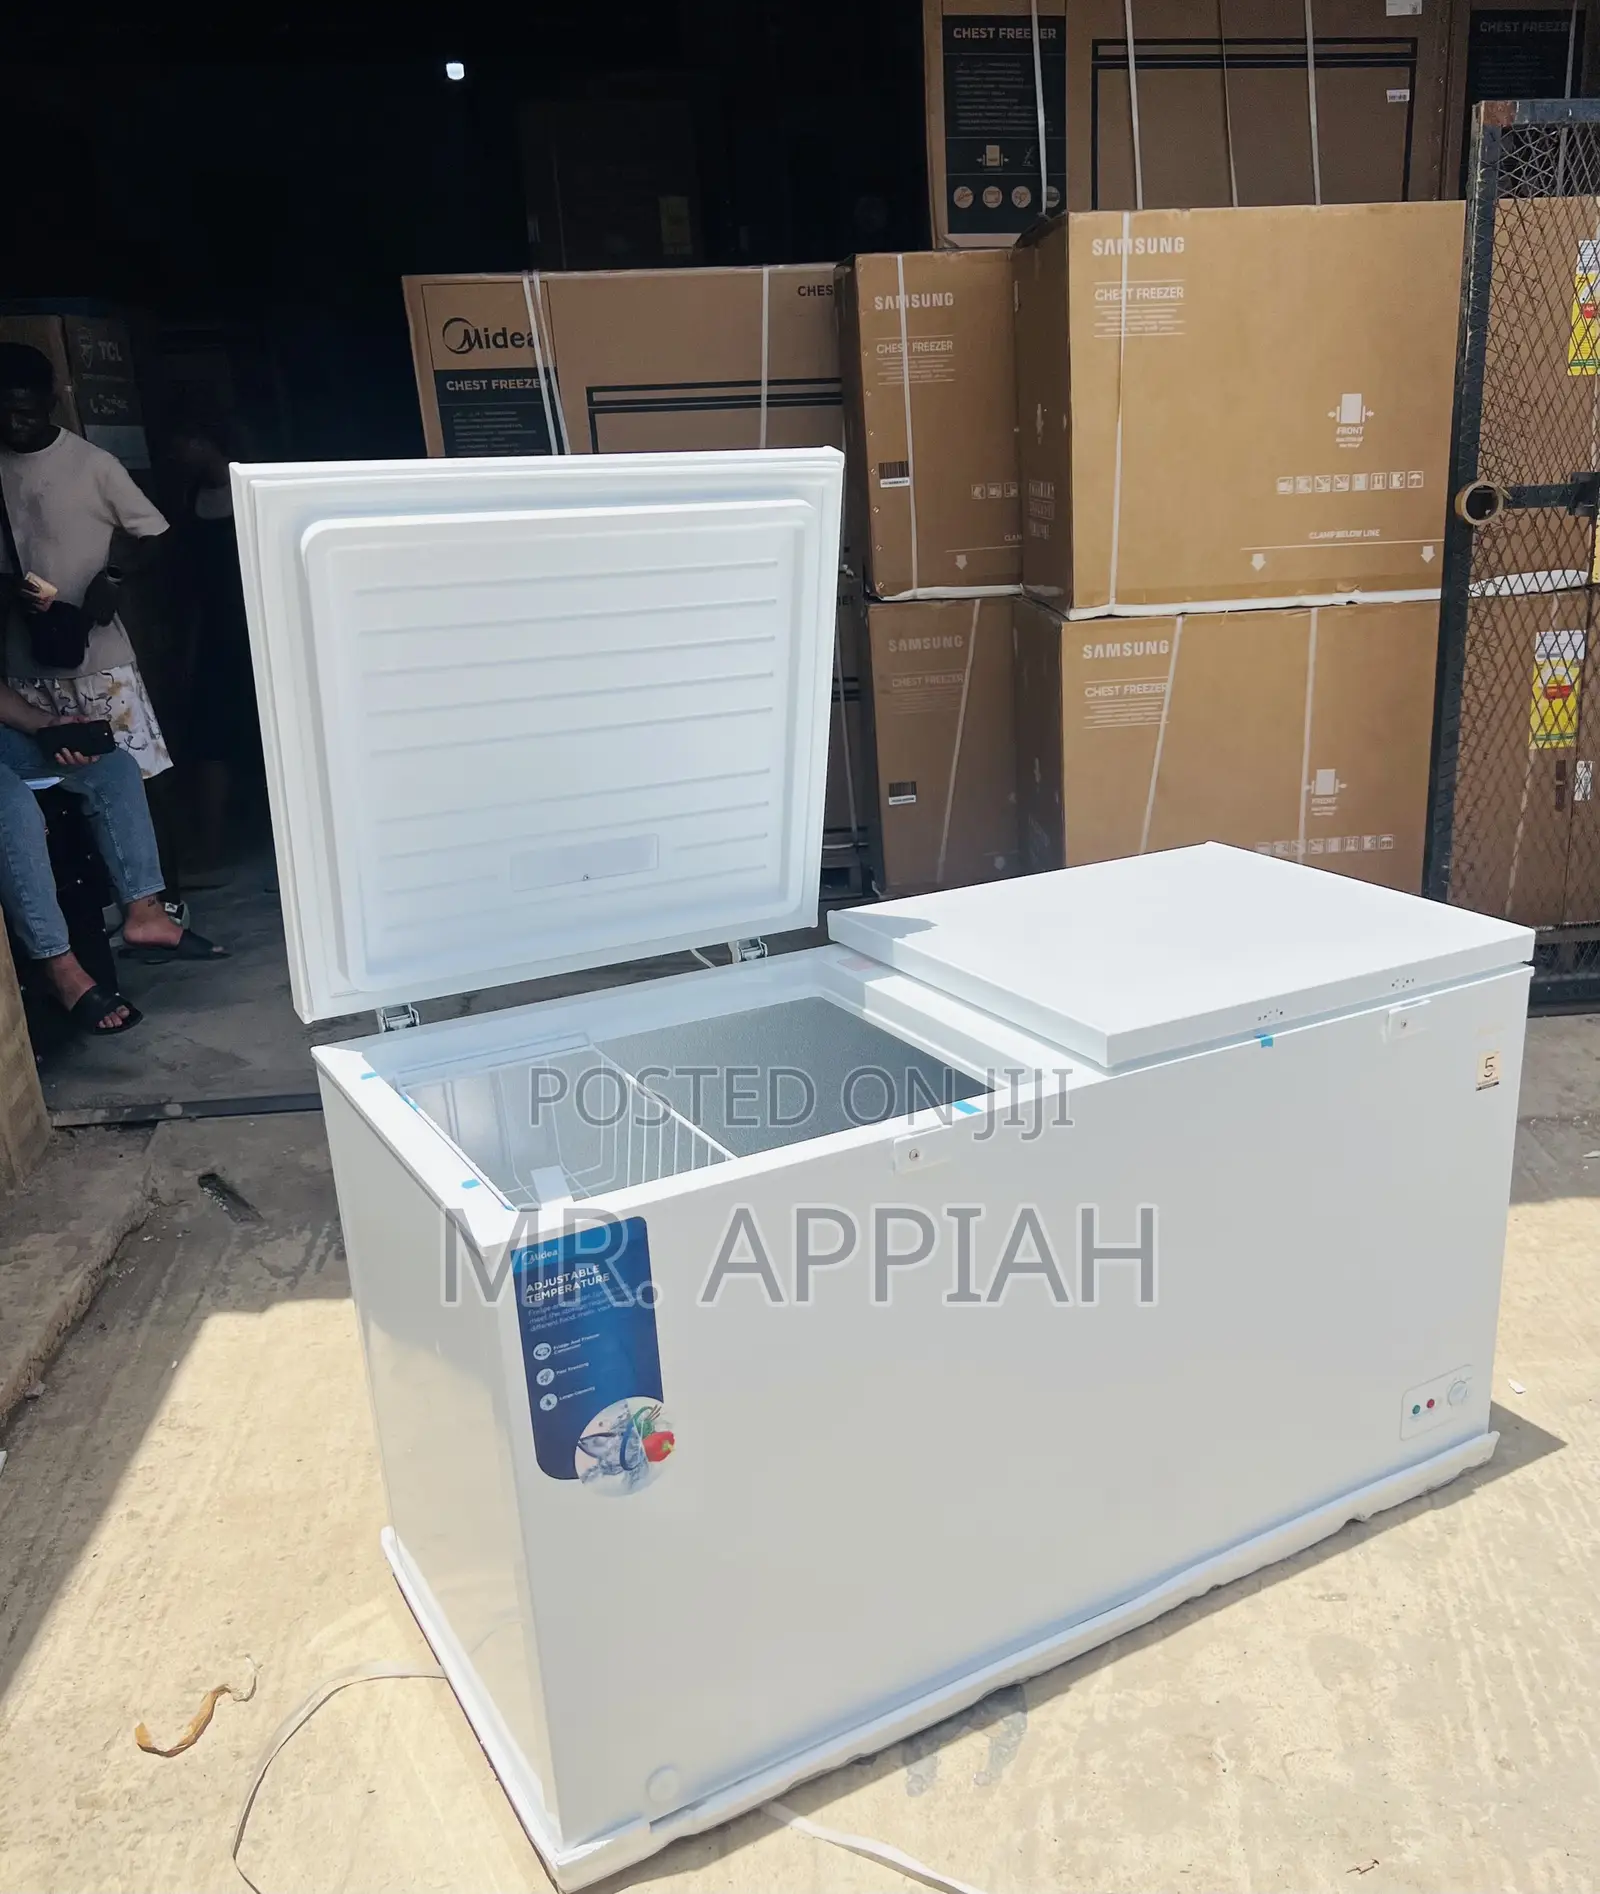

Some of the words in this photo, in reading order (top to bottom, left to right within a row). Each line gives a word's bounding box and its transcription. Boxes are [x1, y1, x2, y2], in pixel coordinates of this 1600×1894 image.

[953, 27, 996, 39] CHEST
[998, 27, 1057, 39] FREEER
[1480, 21, 1519, 32] CHEST
[1522, 20, 1570, 32] FREEZE
[1092, 236, 1185, 256] SAMSUNG
[798, 284, 833, 297] CHES
[1094, 287, 1133, 301] CHET
[1136, 286, 1184, 300] FREEZER
[874, 292, 954, 311] SAMSUNG
[876, 342, 909, 355] CHES
[912, 340, 953, 353] FREEZER
[446, 379, 489, 391] CHEST
[491, 378, 542, 390] FREEZE
[1363, 529, 1380, 537] LINE
[888, 634, 964, 652] SAMSUNG
[1083, 639, 1170, 660] SAMSUNG
[892, 676, 922, 688] CHEST
[1084, 685, 1121, 698] CHEST
[526, 1265, 600, 1294] ADJUSTABLE
[526, 1273, 610, 1304] TEMPERATURE
